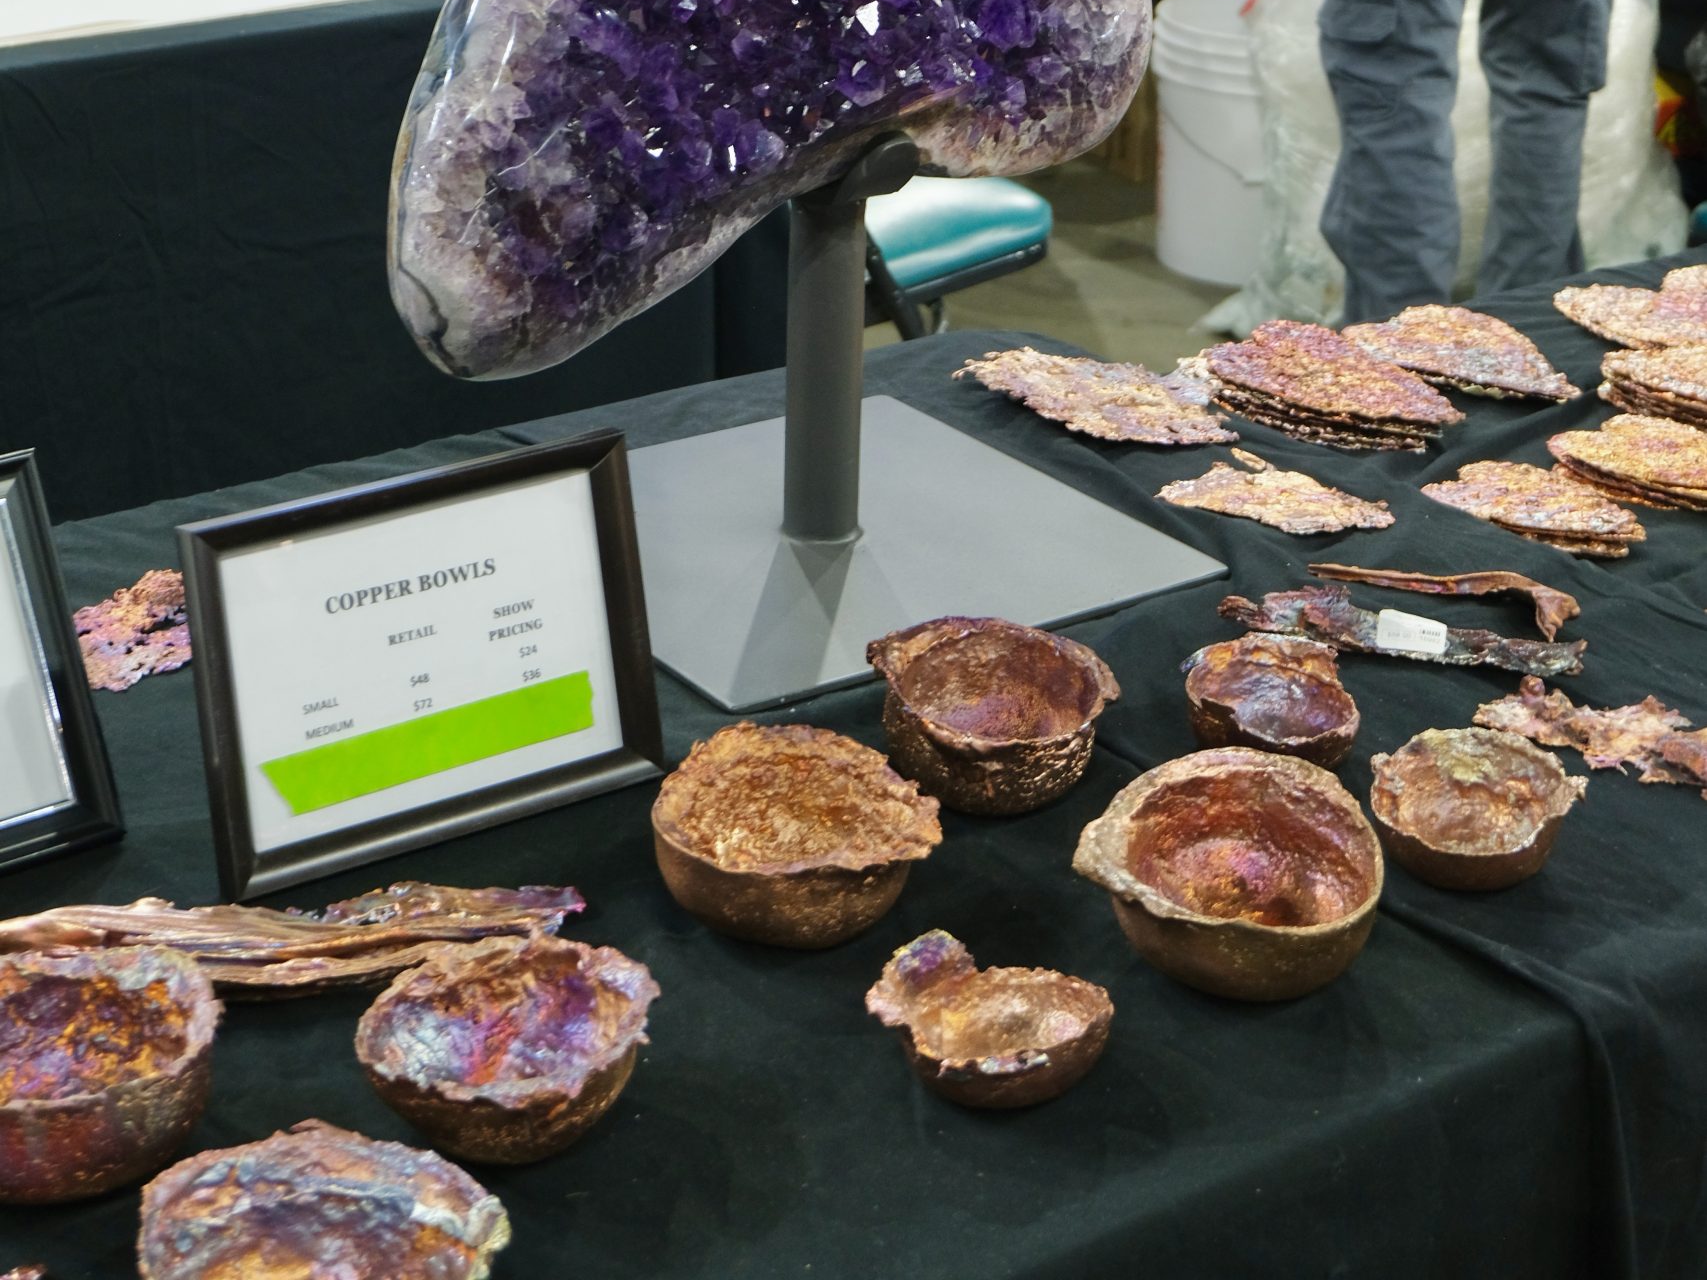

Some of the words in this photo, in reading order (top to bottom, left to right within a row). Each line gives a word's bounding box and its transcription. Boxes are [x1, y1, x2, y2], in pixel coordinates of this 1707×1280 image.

[325, 579, 413, 614] COPPER
[418, 558, 496, 592] BOWLS
[493, 599, 535, 619] SHOW
[388, 625, 437, 646] RETAIL
[488, 619, 543, 642] PRICING
[302, 697, 339, 715] SMALL
[410, 673, 430, 687] $48
[519, 644, 538, 658] $24
[305, 718, 354, 740] MEDIUM
[413, 698, 433, 712] $72
[522, 668, 541, 682] $36
